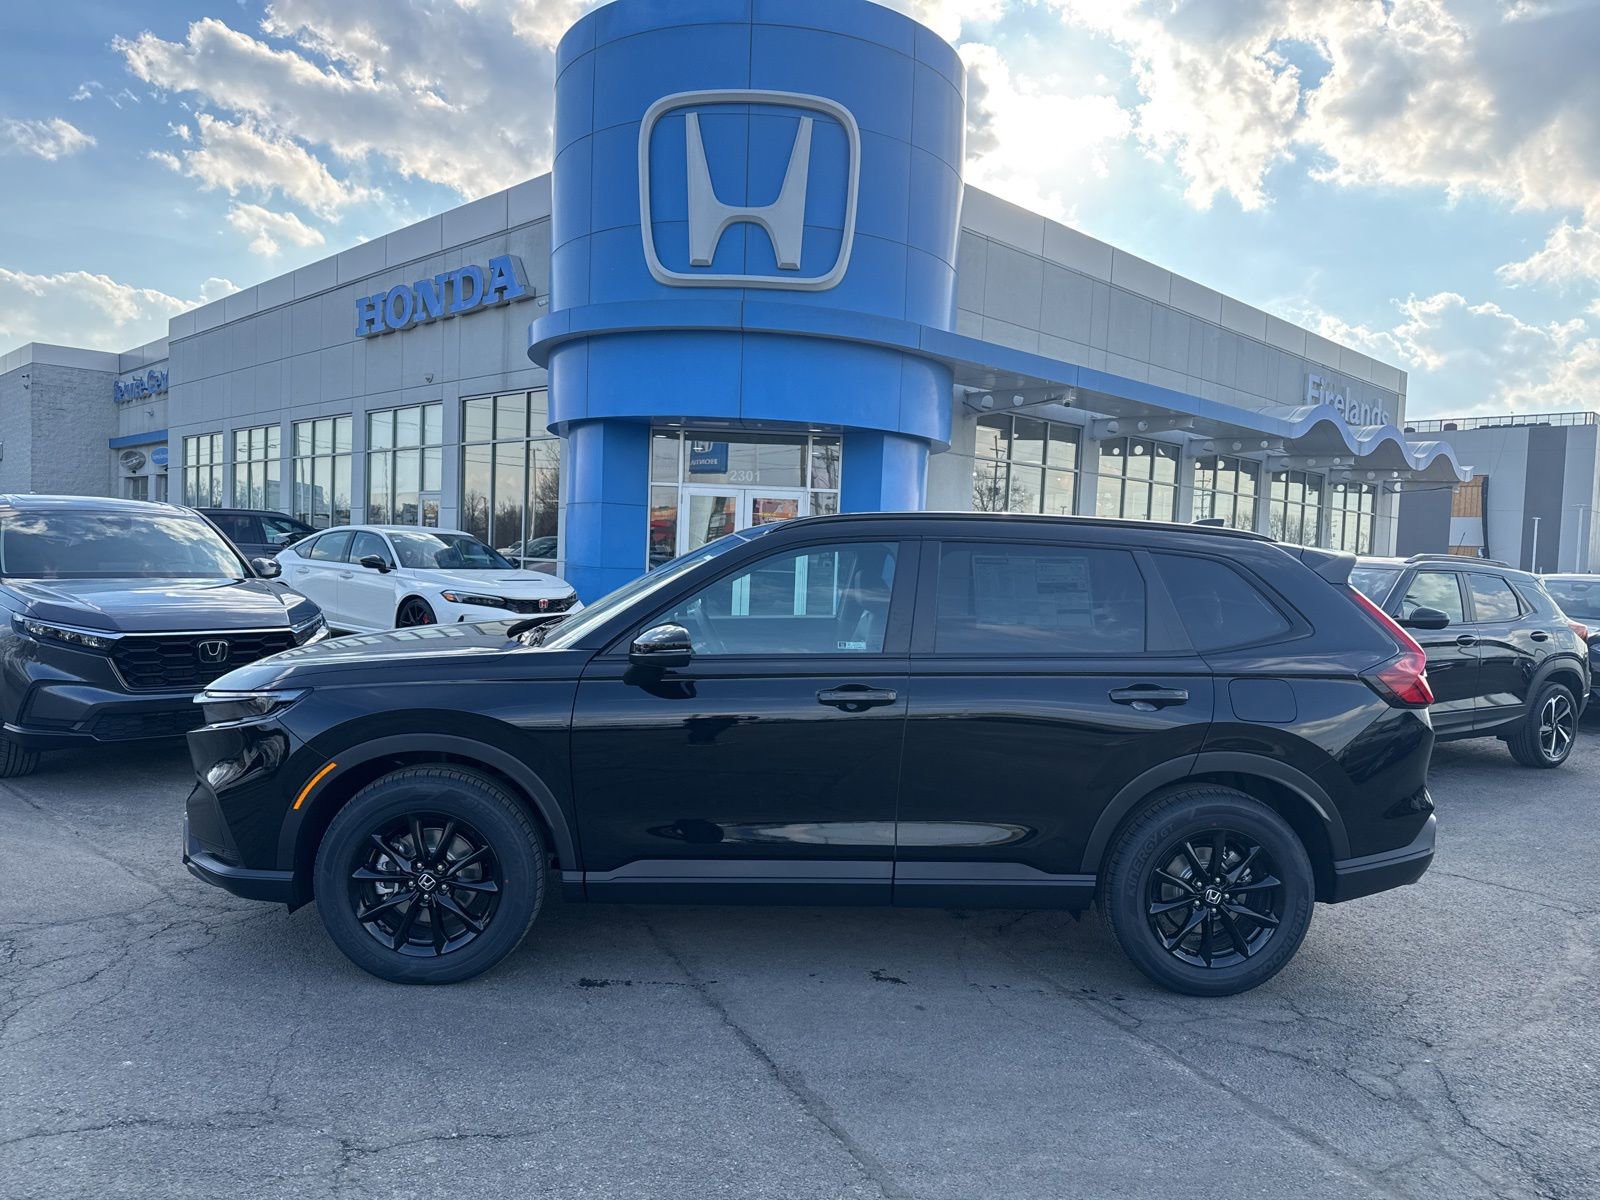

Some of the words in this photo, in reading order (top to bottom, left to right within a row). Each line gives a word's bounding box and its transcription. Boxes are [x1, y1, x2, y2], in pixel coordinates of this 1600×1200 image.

[356, 254, 533, 337] HONDA
[1307, 373, 1390, 425] Firelands
[729, 470, 760, 482] 2301
